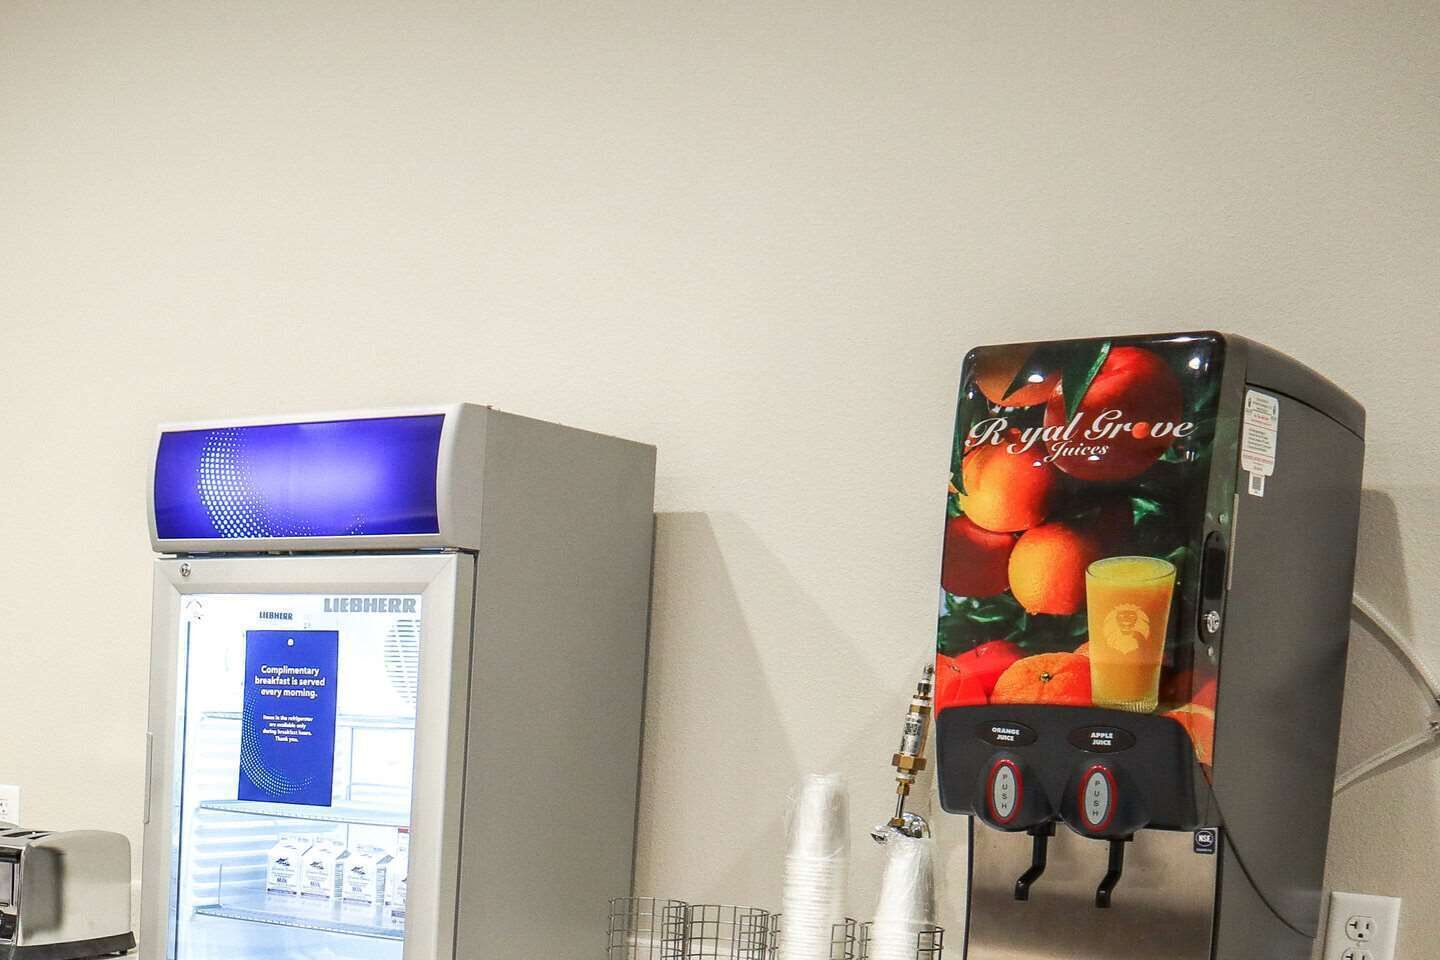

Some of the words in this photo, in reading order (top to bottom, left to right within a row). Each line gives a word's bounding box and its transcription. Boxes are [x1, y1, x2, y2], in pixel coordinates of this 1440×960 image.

[965, 411, 1085, 455] Royal
[1084, 409, 1200, 440] Grove
[1043, 441, 1110, 463] Juices
[323, 597, 417, 614] LIEBHERR
[259, 611, 294, 621] LIEBHERR
[261, 665, 320, 677] Complimentary
[255, 676, 290, 686] breakfast
[291, 677, 298, 686] is
[299, 678, 326, 687] served
[261, 689, 282, 698] every
[283, 689, 318, 699] morning.
[991, 727, 1021, 736] ORANGE
[996, 734, 1015, 742] JUICE
[1000, 773, 1009, 809] PUSH
[1091, 780, 1102, 816] PUSH
